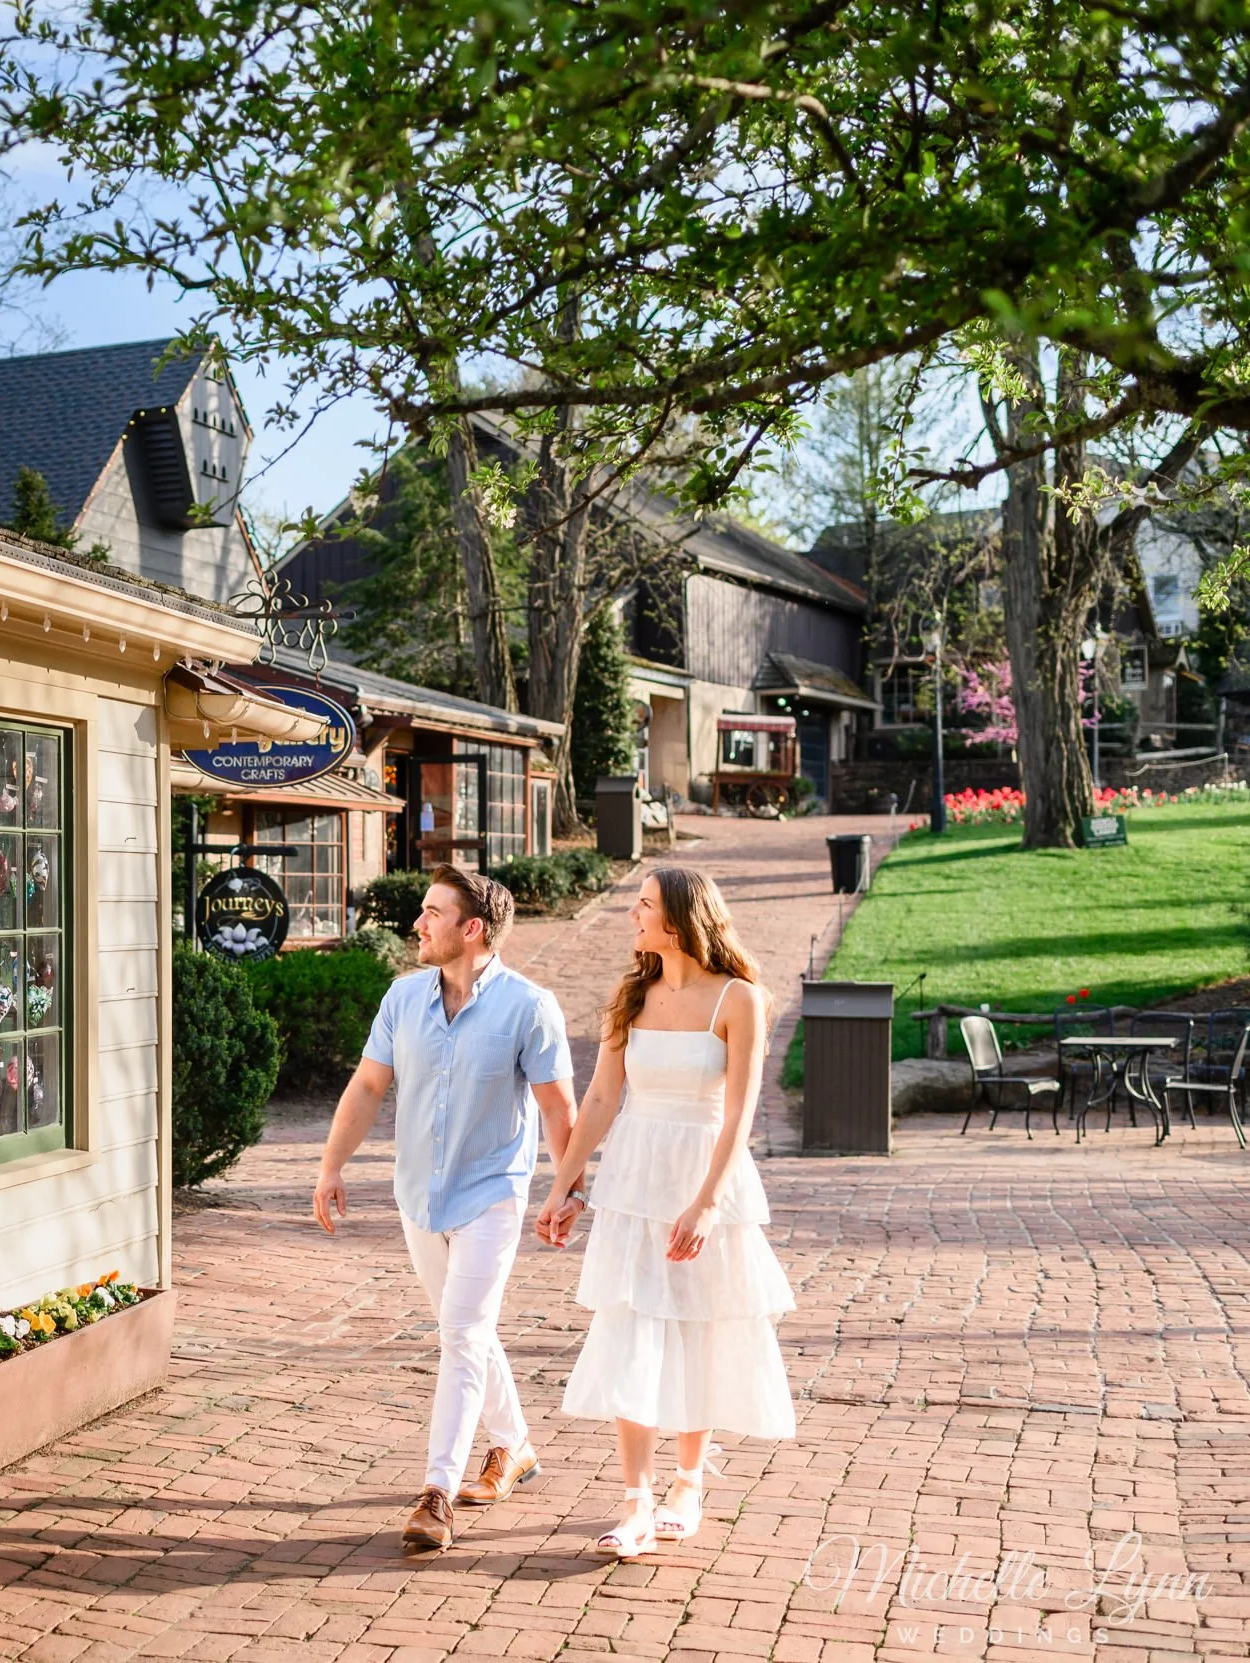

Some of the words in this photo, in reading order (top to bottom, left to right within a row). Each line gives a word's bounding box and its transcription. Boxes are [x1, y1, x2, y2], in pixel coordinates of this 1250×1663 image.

[212, 755, 315, 768] CONTEMPORARY
[241, 768, 286, 780] CRAFTS
[202, 896, 285, 925] Journeys
